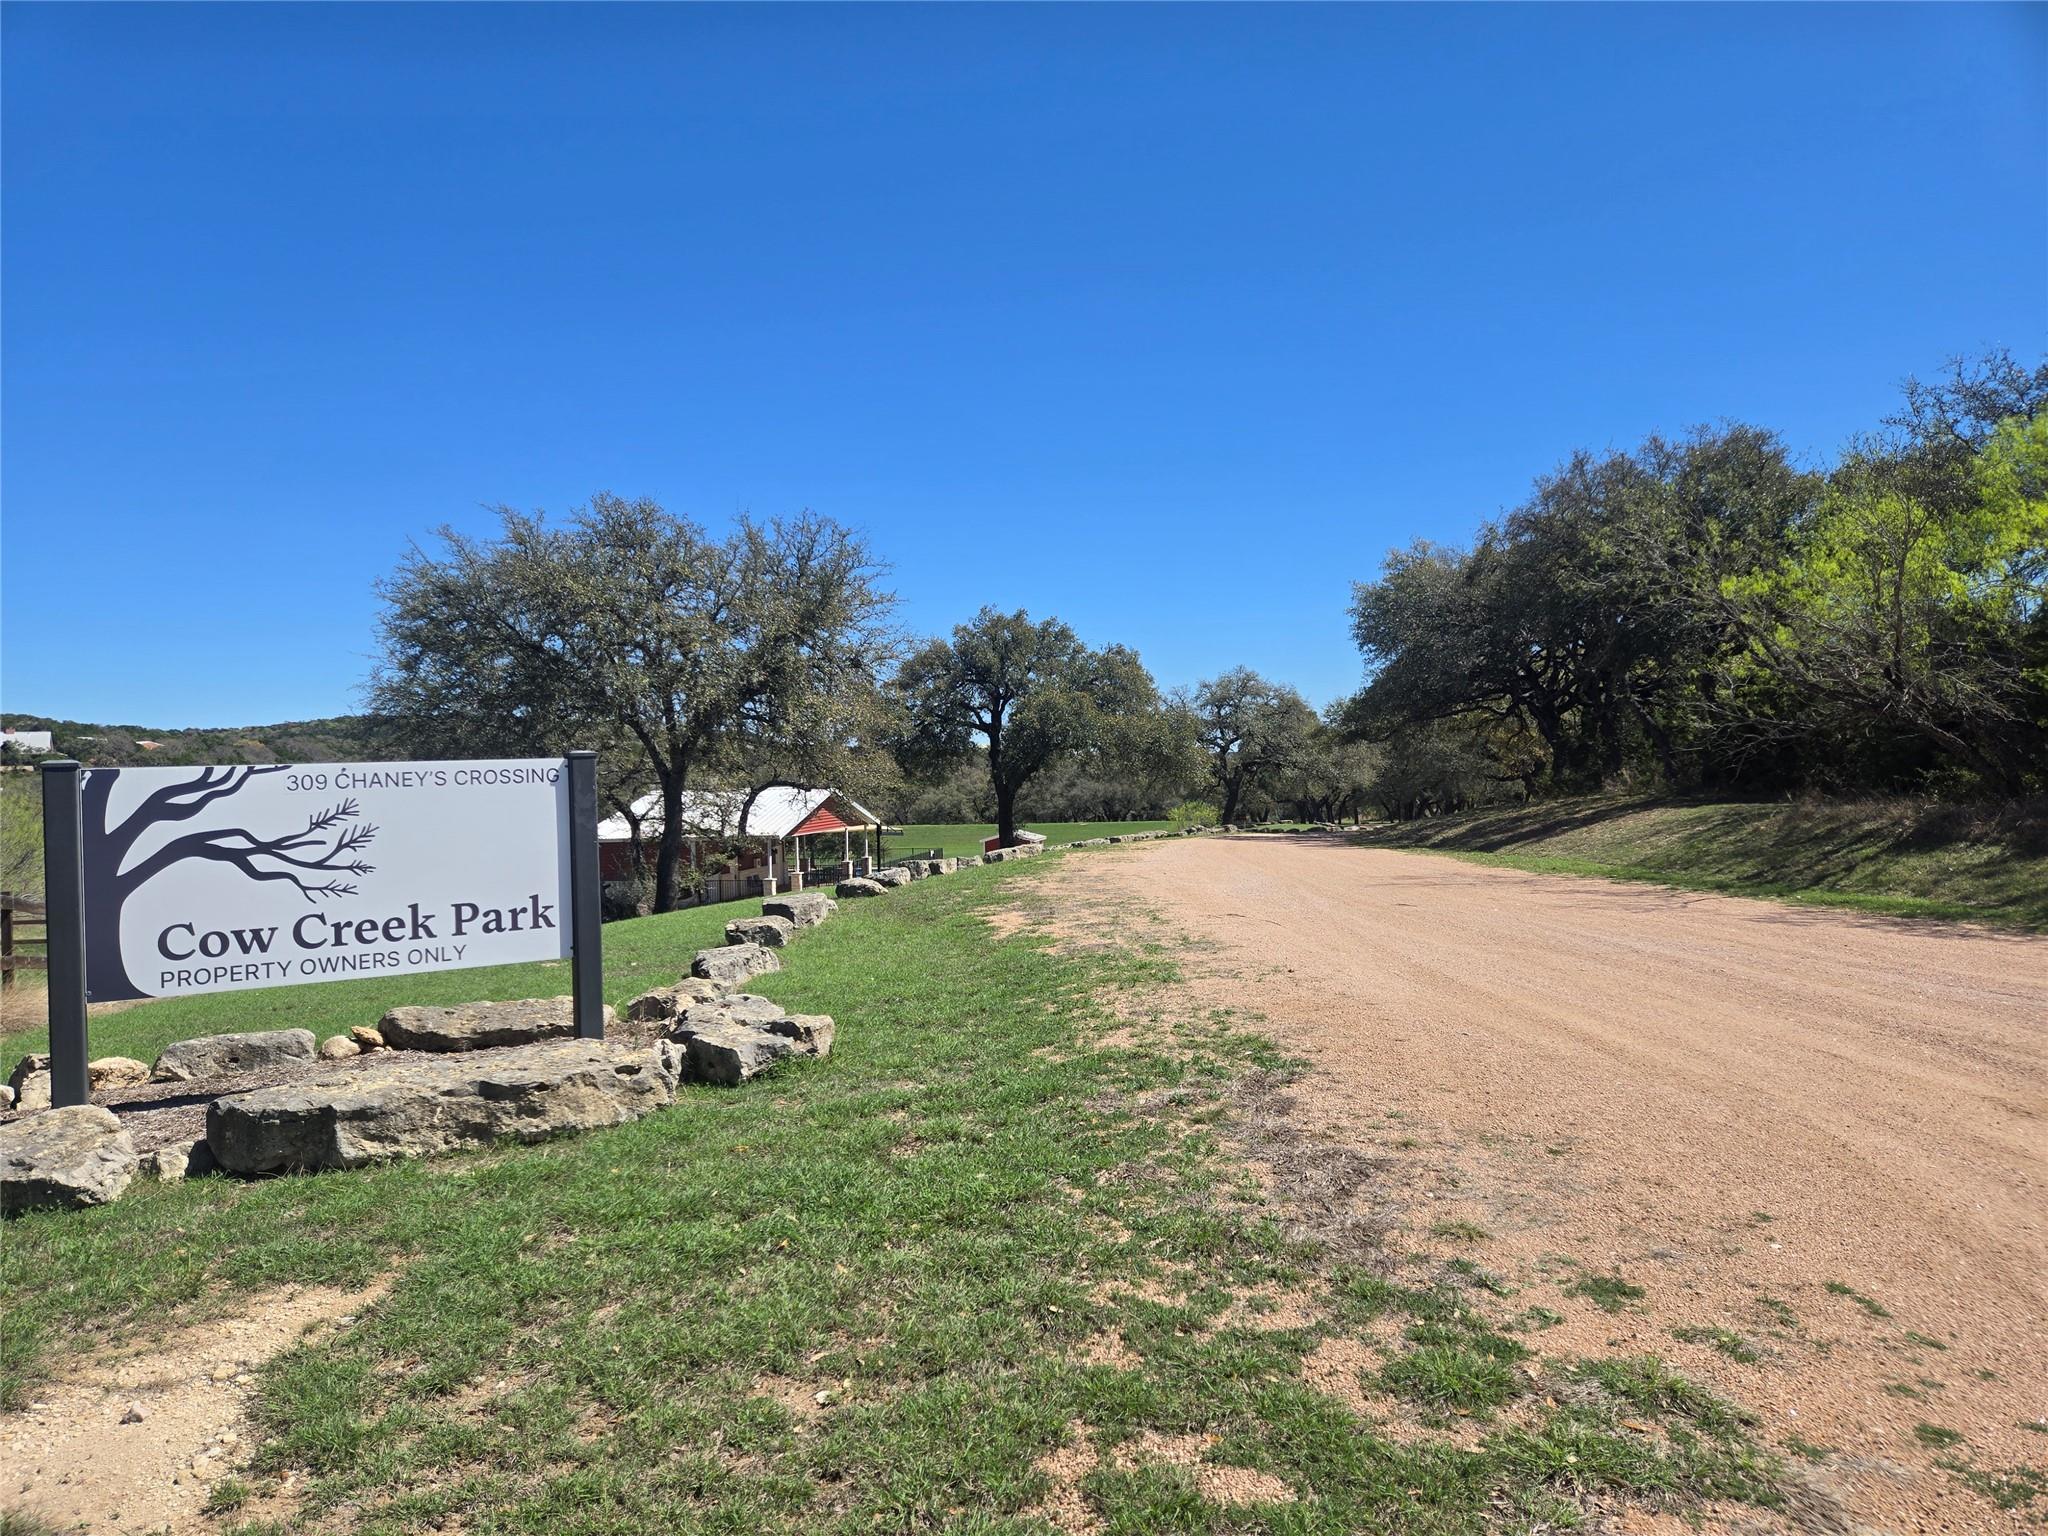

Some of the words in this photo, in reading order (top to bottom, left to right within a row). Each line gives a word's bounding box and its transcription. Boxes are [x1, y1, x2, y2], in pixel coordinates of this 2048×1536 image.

[286, 774, 328, 792] 309
[334, 770, 447, 790] CHANEY'S
[454, 764, 561, 786] CROSSING
[157, 921, 279, 962] Cow
[292, 902, 438, 950] Creek
[450, 893, 556, 937] Park
[160, 960, 292, 989] PROPERTY
[299, 950, 400, 976] OWNERS
[407, 944, 467, 965] ONLY
